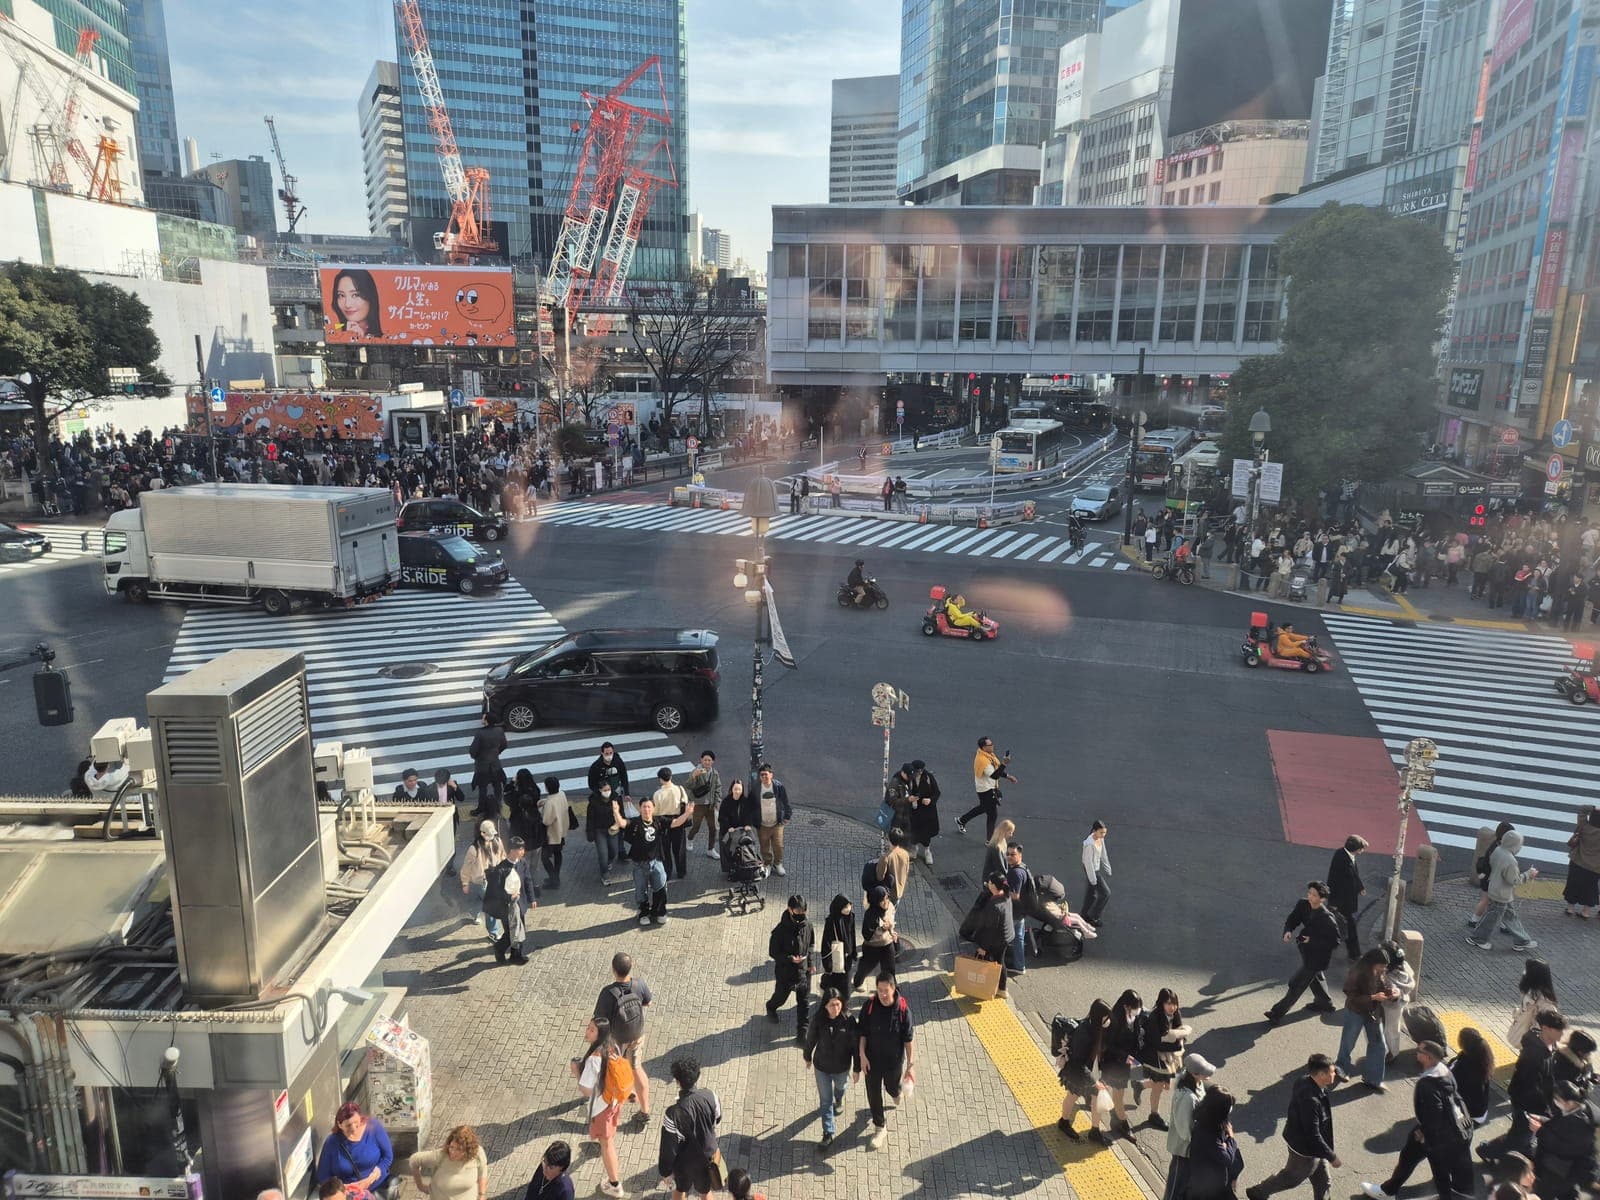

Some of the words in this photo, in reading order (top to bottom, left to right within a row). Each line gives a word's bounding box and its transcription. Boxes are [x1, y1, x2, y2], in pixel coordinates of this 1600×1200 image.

[1421, 193, 1449, 207] CITY
[394, 276, 440, 291] クルマがある
[402, 570, 448, 585] S.RIDE
